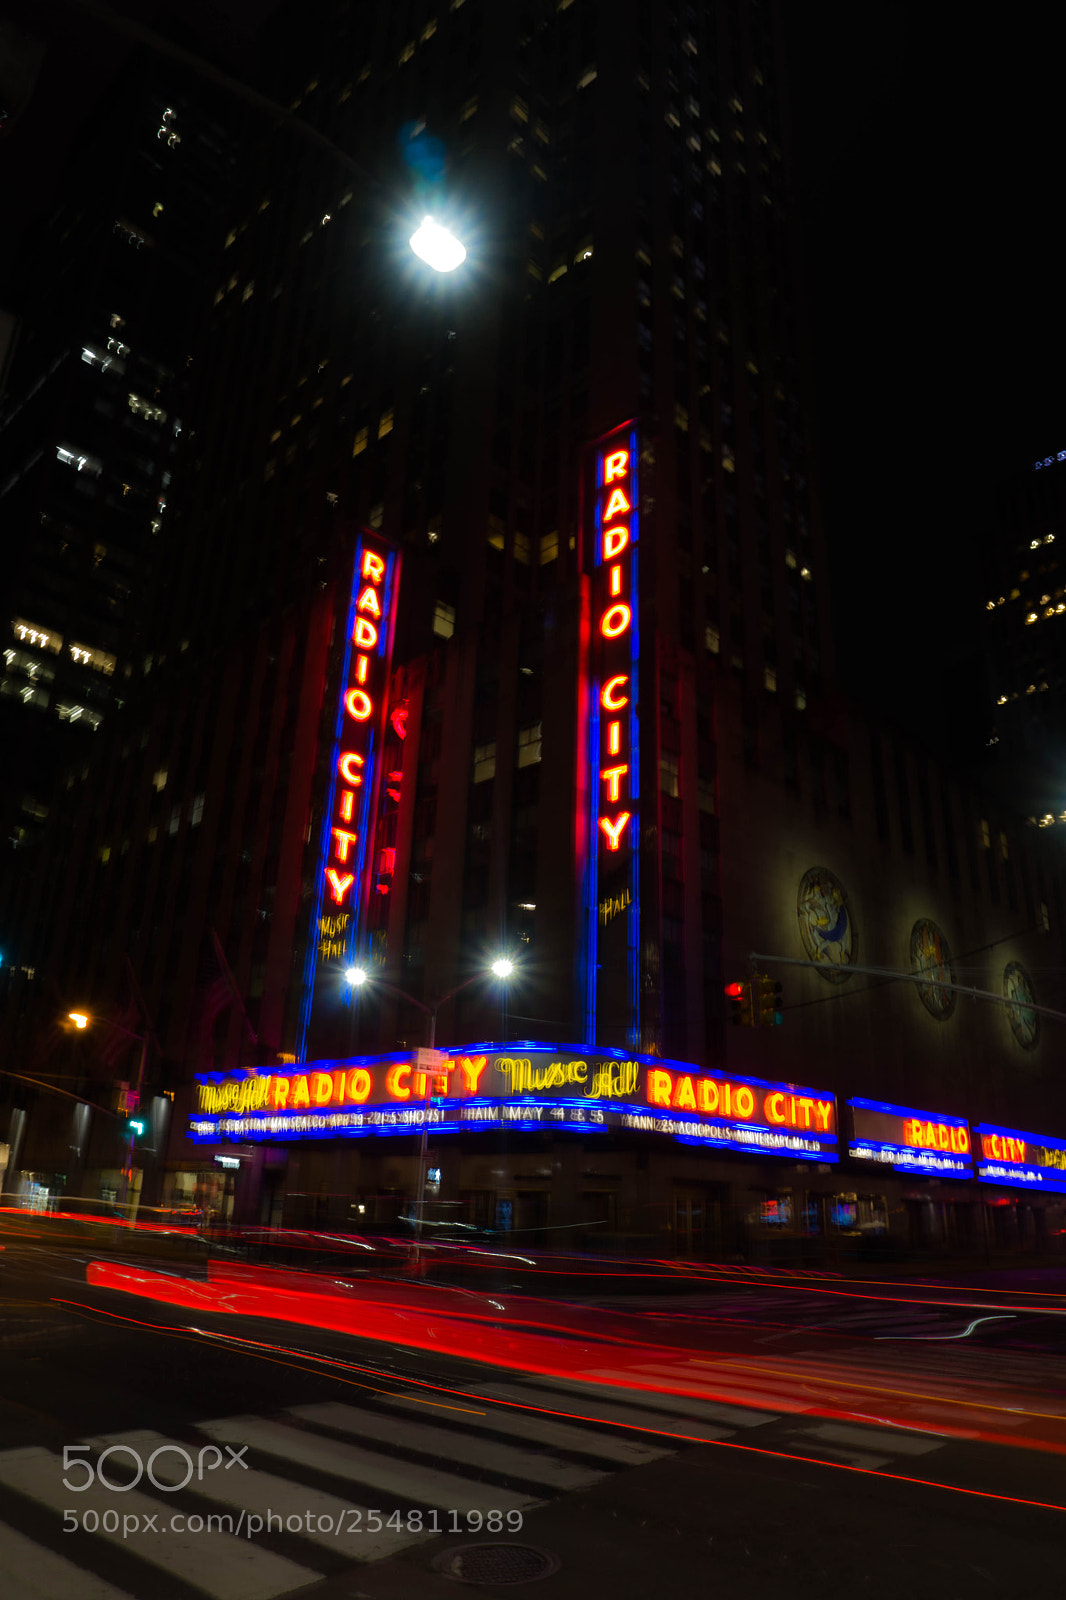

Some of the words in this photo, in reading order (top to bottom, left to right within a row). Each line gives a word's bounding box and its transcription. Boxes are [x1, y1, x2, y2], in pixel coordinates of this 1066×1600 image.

[601, 450, 632, 639] RADIO
[344, 549, 385, 722] RADIO
[598, 674, 631, 852] CITY
[325, 751, 364, 905] CITY
[600, 888, 632, 926] HALL
[270, 1067, 372, 1110] RADIO
[495, 1058, 588, 1094] Music
[646, 1067, 756, 1118] RADIO
[764, 1091, 833, 1131] CITY
[461, 1106, 498, 1121] HAIM
[503, 1106, 543, 1121] MAY
[903, 1118, 969, 1154] RADIO
[982, 1133, 1026, 1164] CITY
